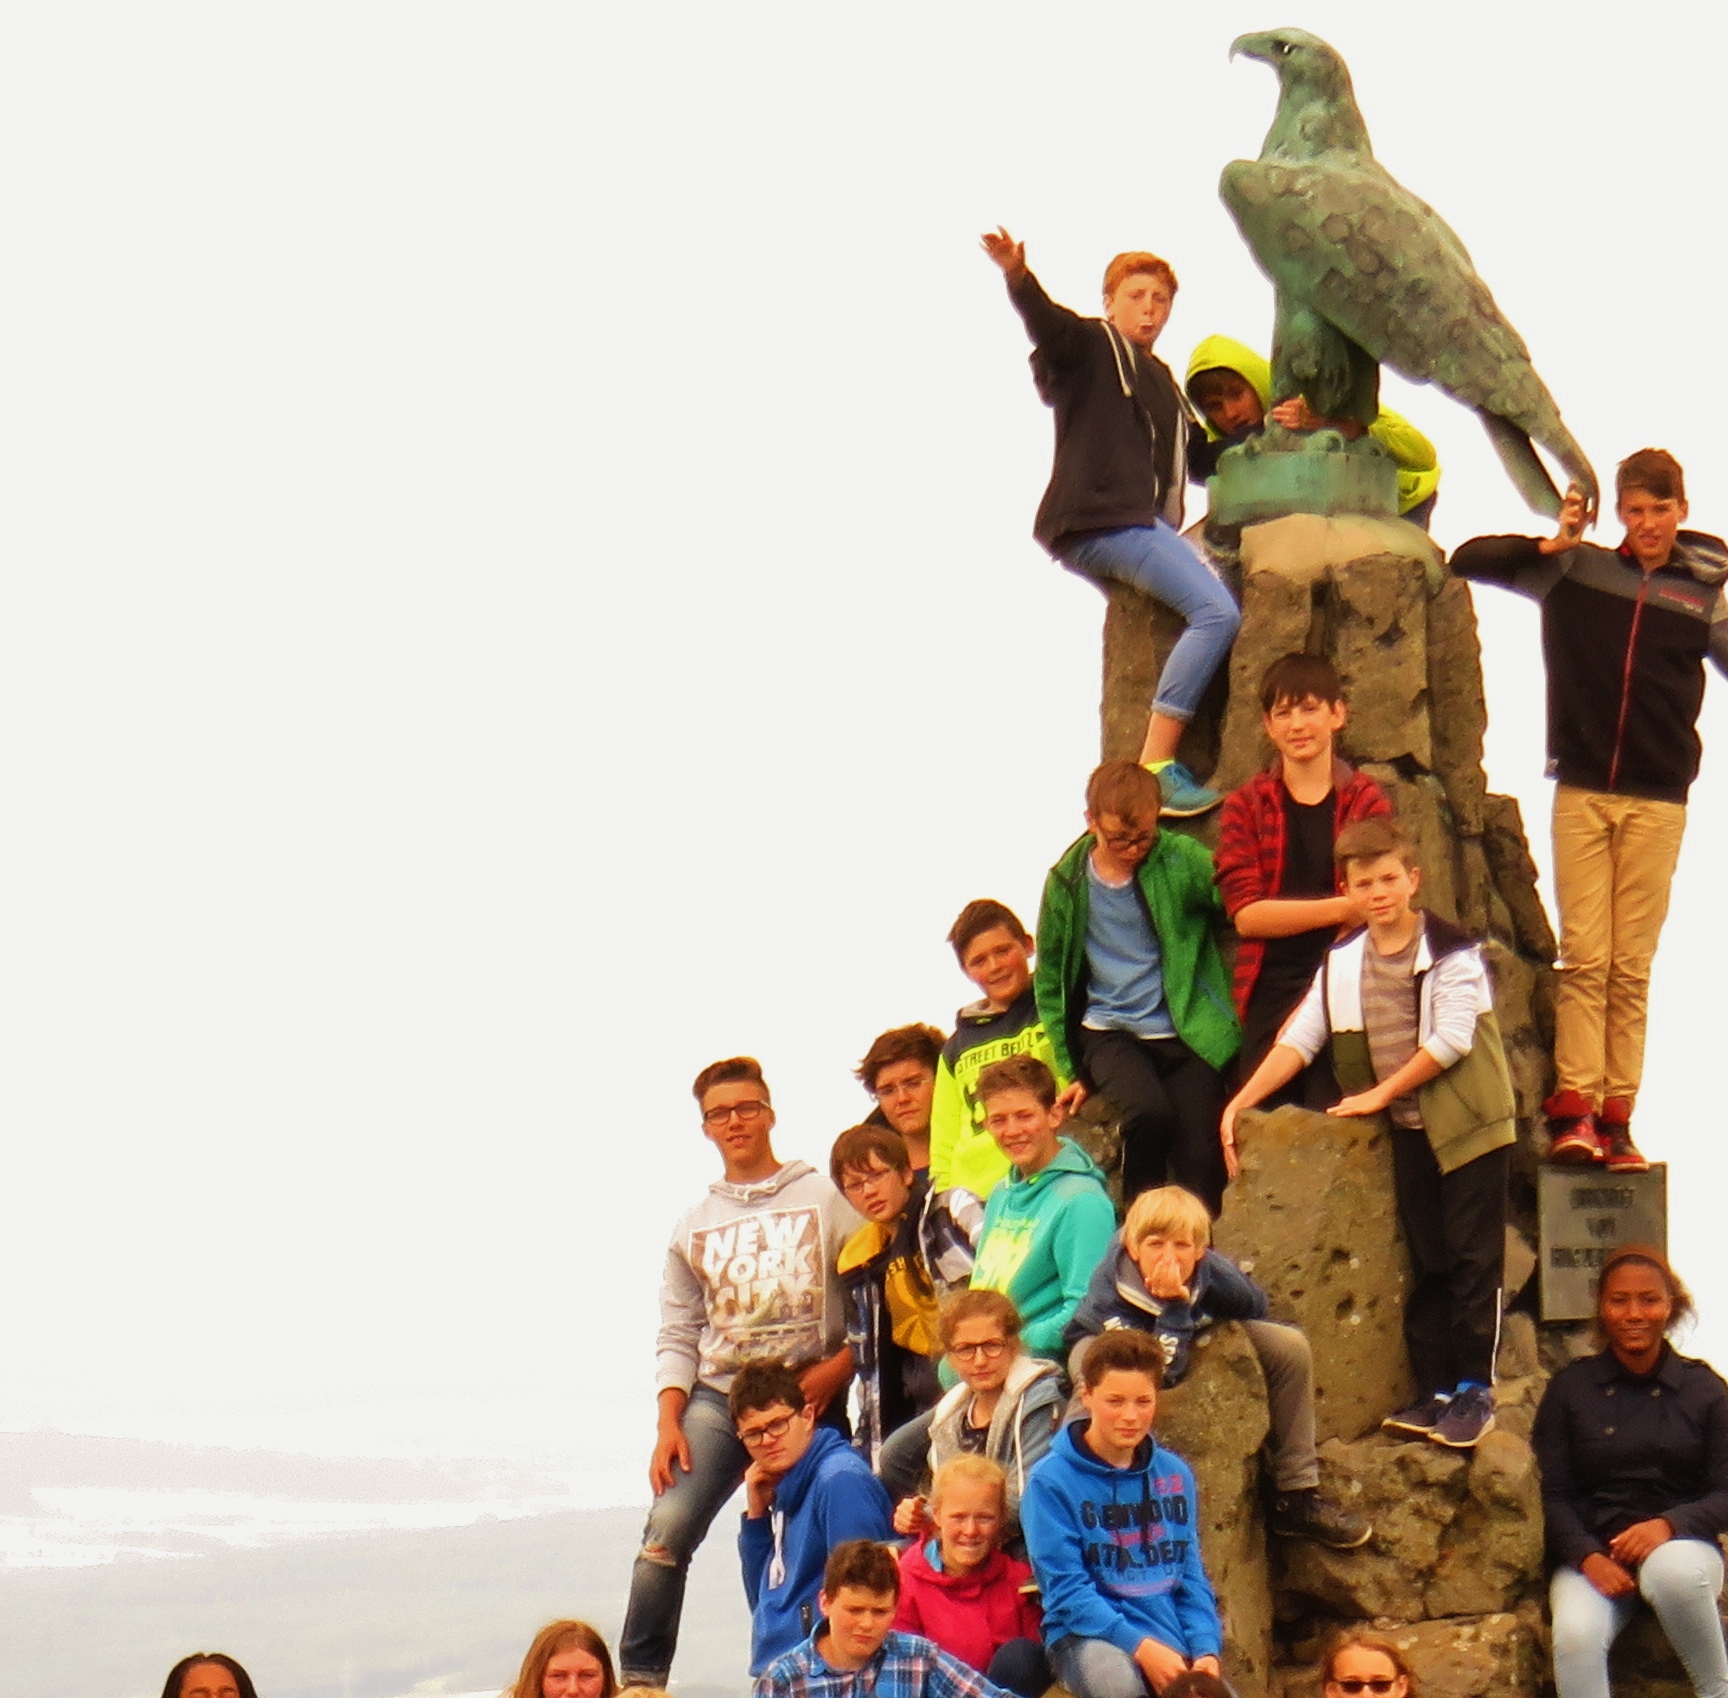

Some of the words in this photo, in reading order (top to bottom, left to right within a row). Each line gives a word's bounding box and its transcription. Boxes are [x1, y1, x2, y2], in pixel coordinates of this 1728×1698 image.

[957, 1045, 997, 1074] STREET
[704, 1213, 811, 1261] NEW
[703, 1245, 814, 1289] YORK
[713, 1273, 816, 1323] CITY
